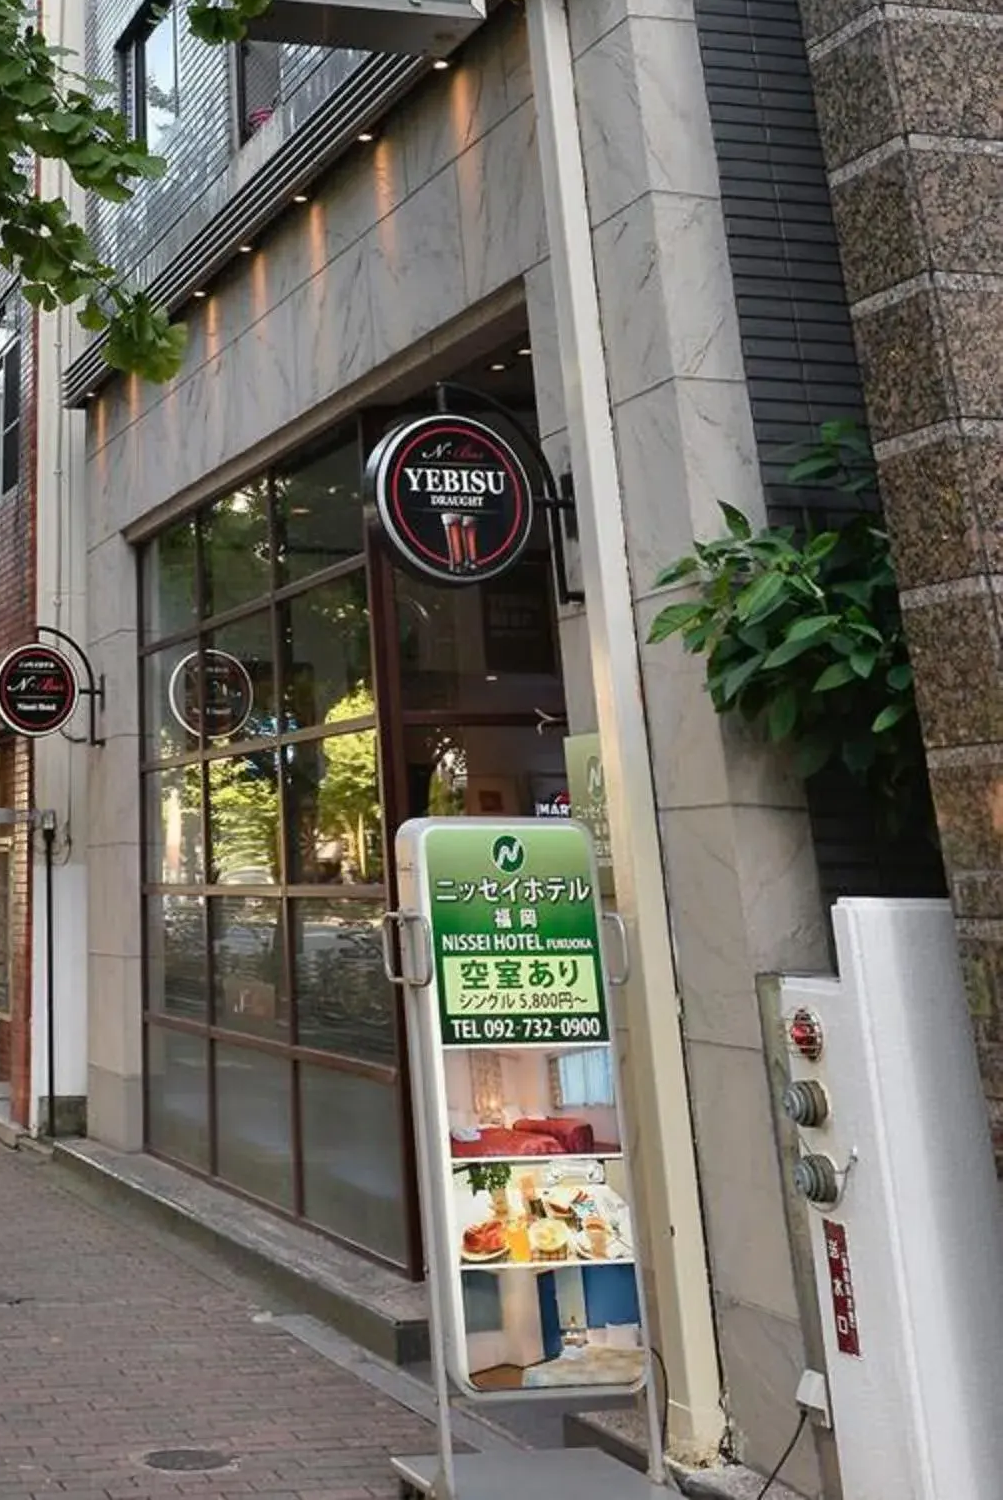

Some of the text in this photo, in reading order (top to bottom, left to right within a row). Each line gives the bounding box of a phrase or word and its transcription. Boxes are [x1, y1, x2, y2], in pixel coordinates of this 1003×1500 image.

[404, 467, 506, 495] YEBISU
[437, 876, 591, 903] ニッセイホテル
[442, 932, 593, 951] NISSEI HOTEL FUKUOKA
[460, 959, 579, 990] 空室あり
[451, 1017, 601, 1039] TEL 092-732-0900
